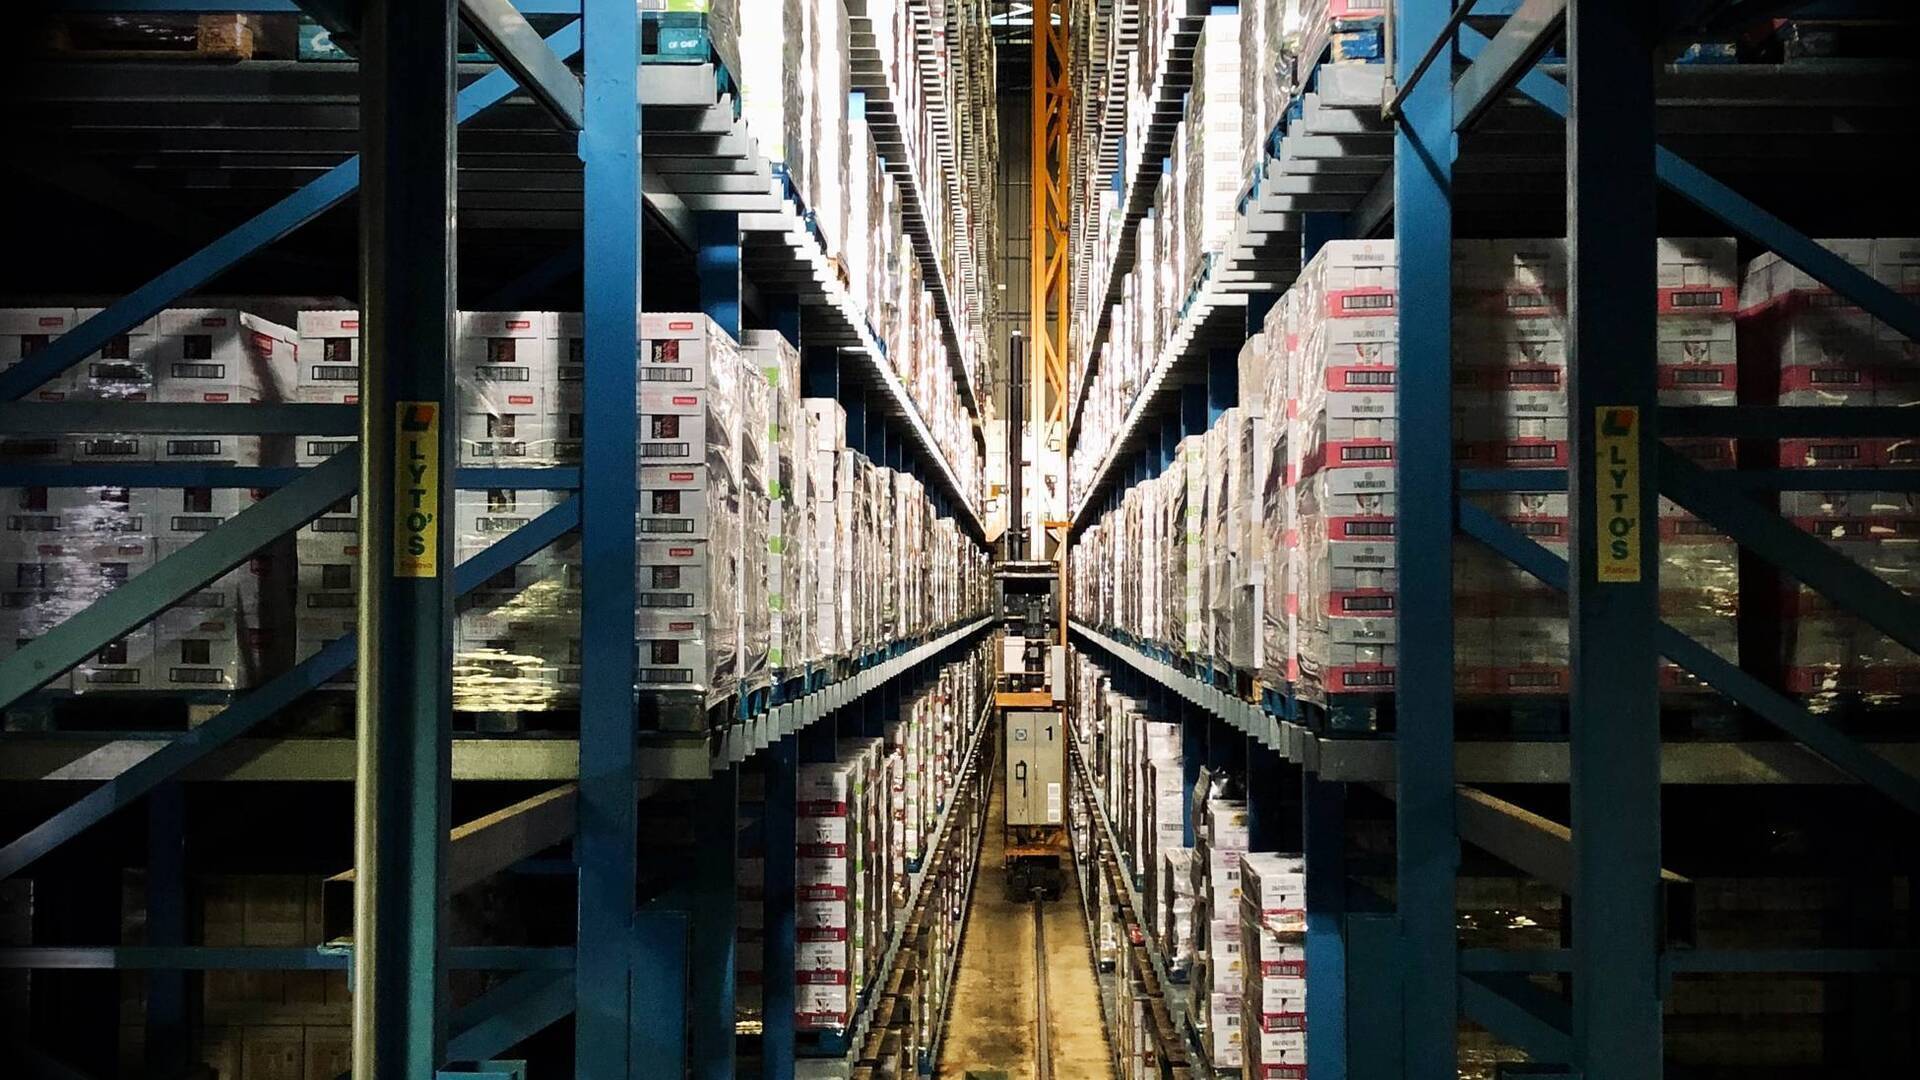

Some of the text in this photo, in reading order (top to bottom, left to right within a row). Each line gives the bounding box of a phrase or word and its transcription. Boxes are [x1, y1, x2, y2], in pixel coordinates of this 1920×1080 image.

[407, 440, 434, 556] LYTO'S
[1608, 445, 1636, 560] LYTO'S
[1045, 725, 1053, 741] 1
